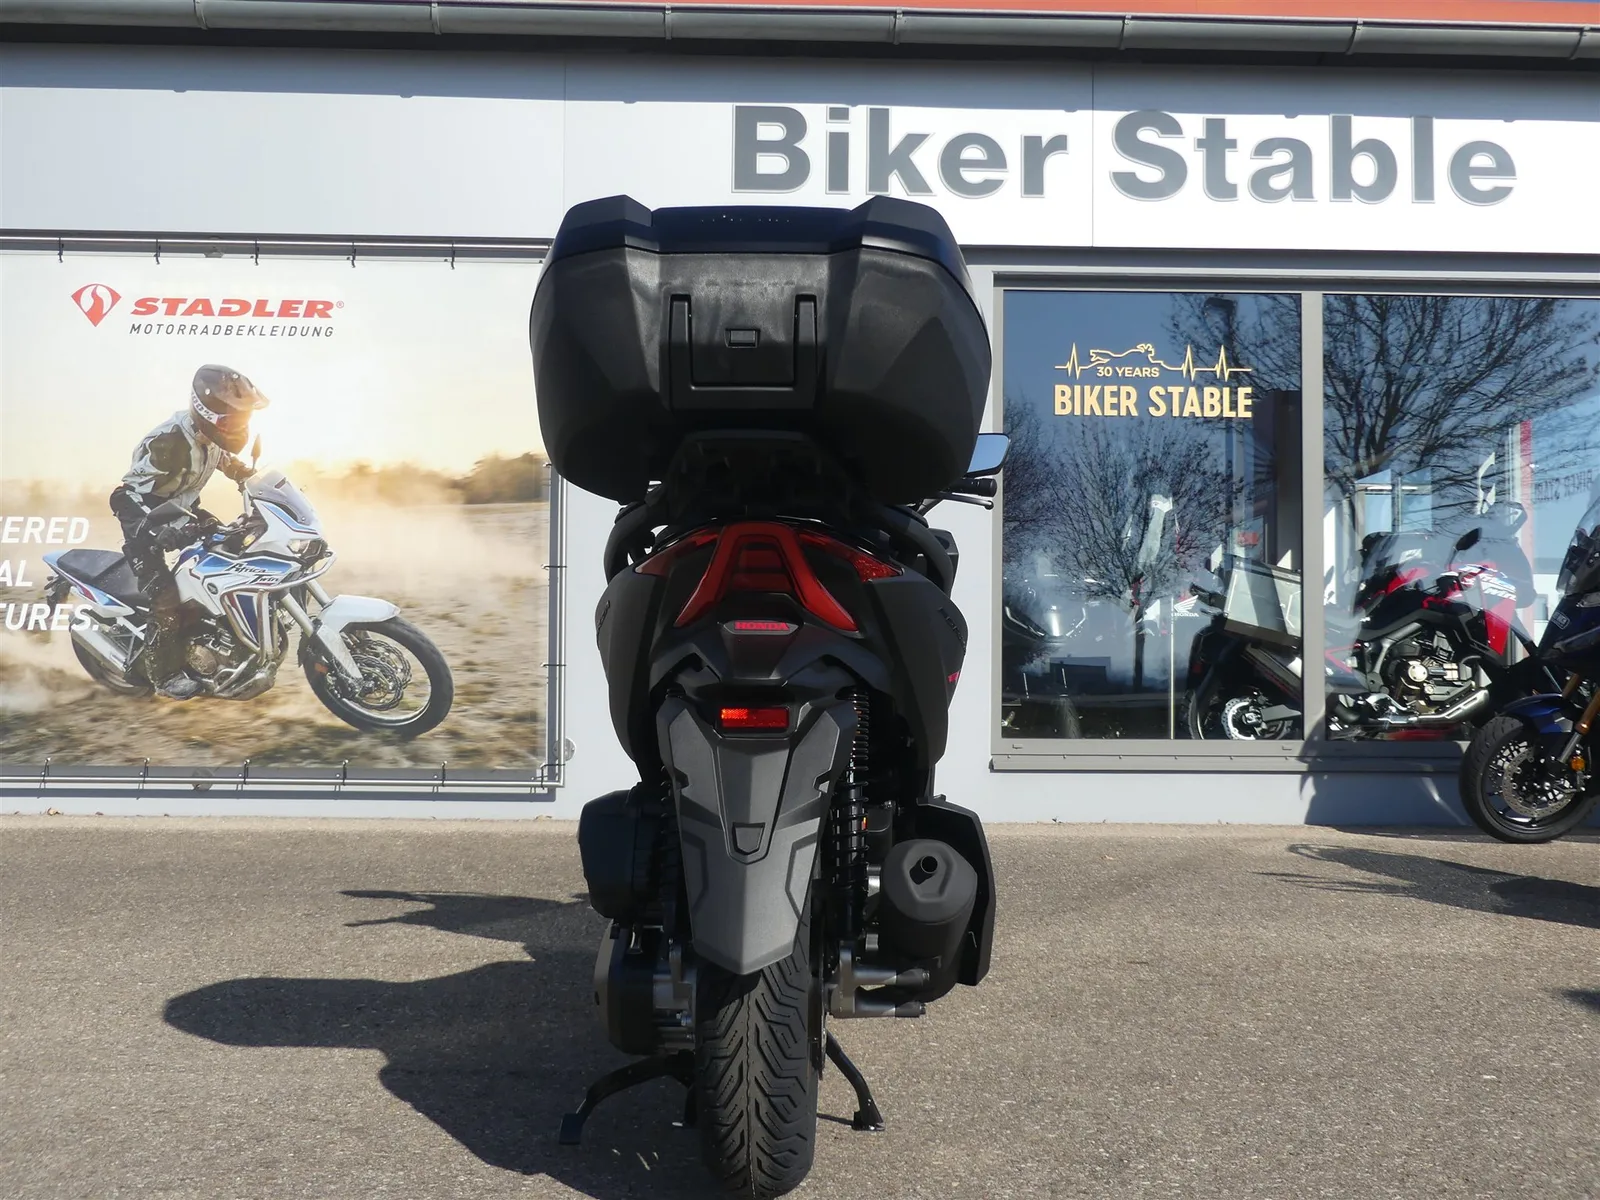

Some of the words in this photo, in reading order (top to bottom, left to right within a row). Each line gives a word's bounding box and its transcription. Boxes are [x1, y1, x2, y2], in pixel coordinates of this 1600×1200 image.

[731, 104, 1069, 199] Biker
[1109, 109, 1518, 206] Stable
[129, 323, 334, 338] MOTORRADBEKLEIDUNG
[1096, 366, 1112, 378] 30
[1116, 366, 1160, 378] YEARS
[1054, 384, 1138, 416] BIKER
[1149, 386, 1252, 418] STABLE
[0, 516, 90, 544] ERED
[0, 603, 99, 631] URES.
[734, 621, 790, 631] HONDA
